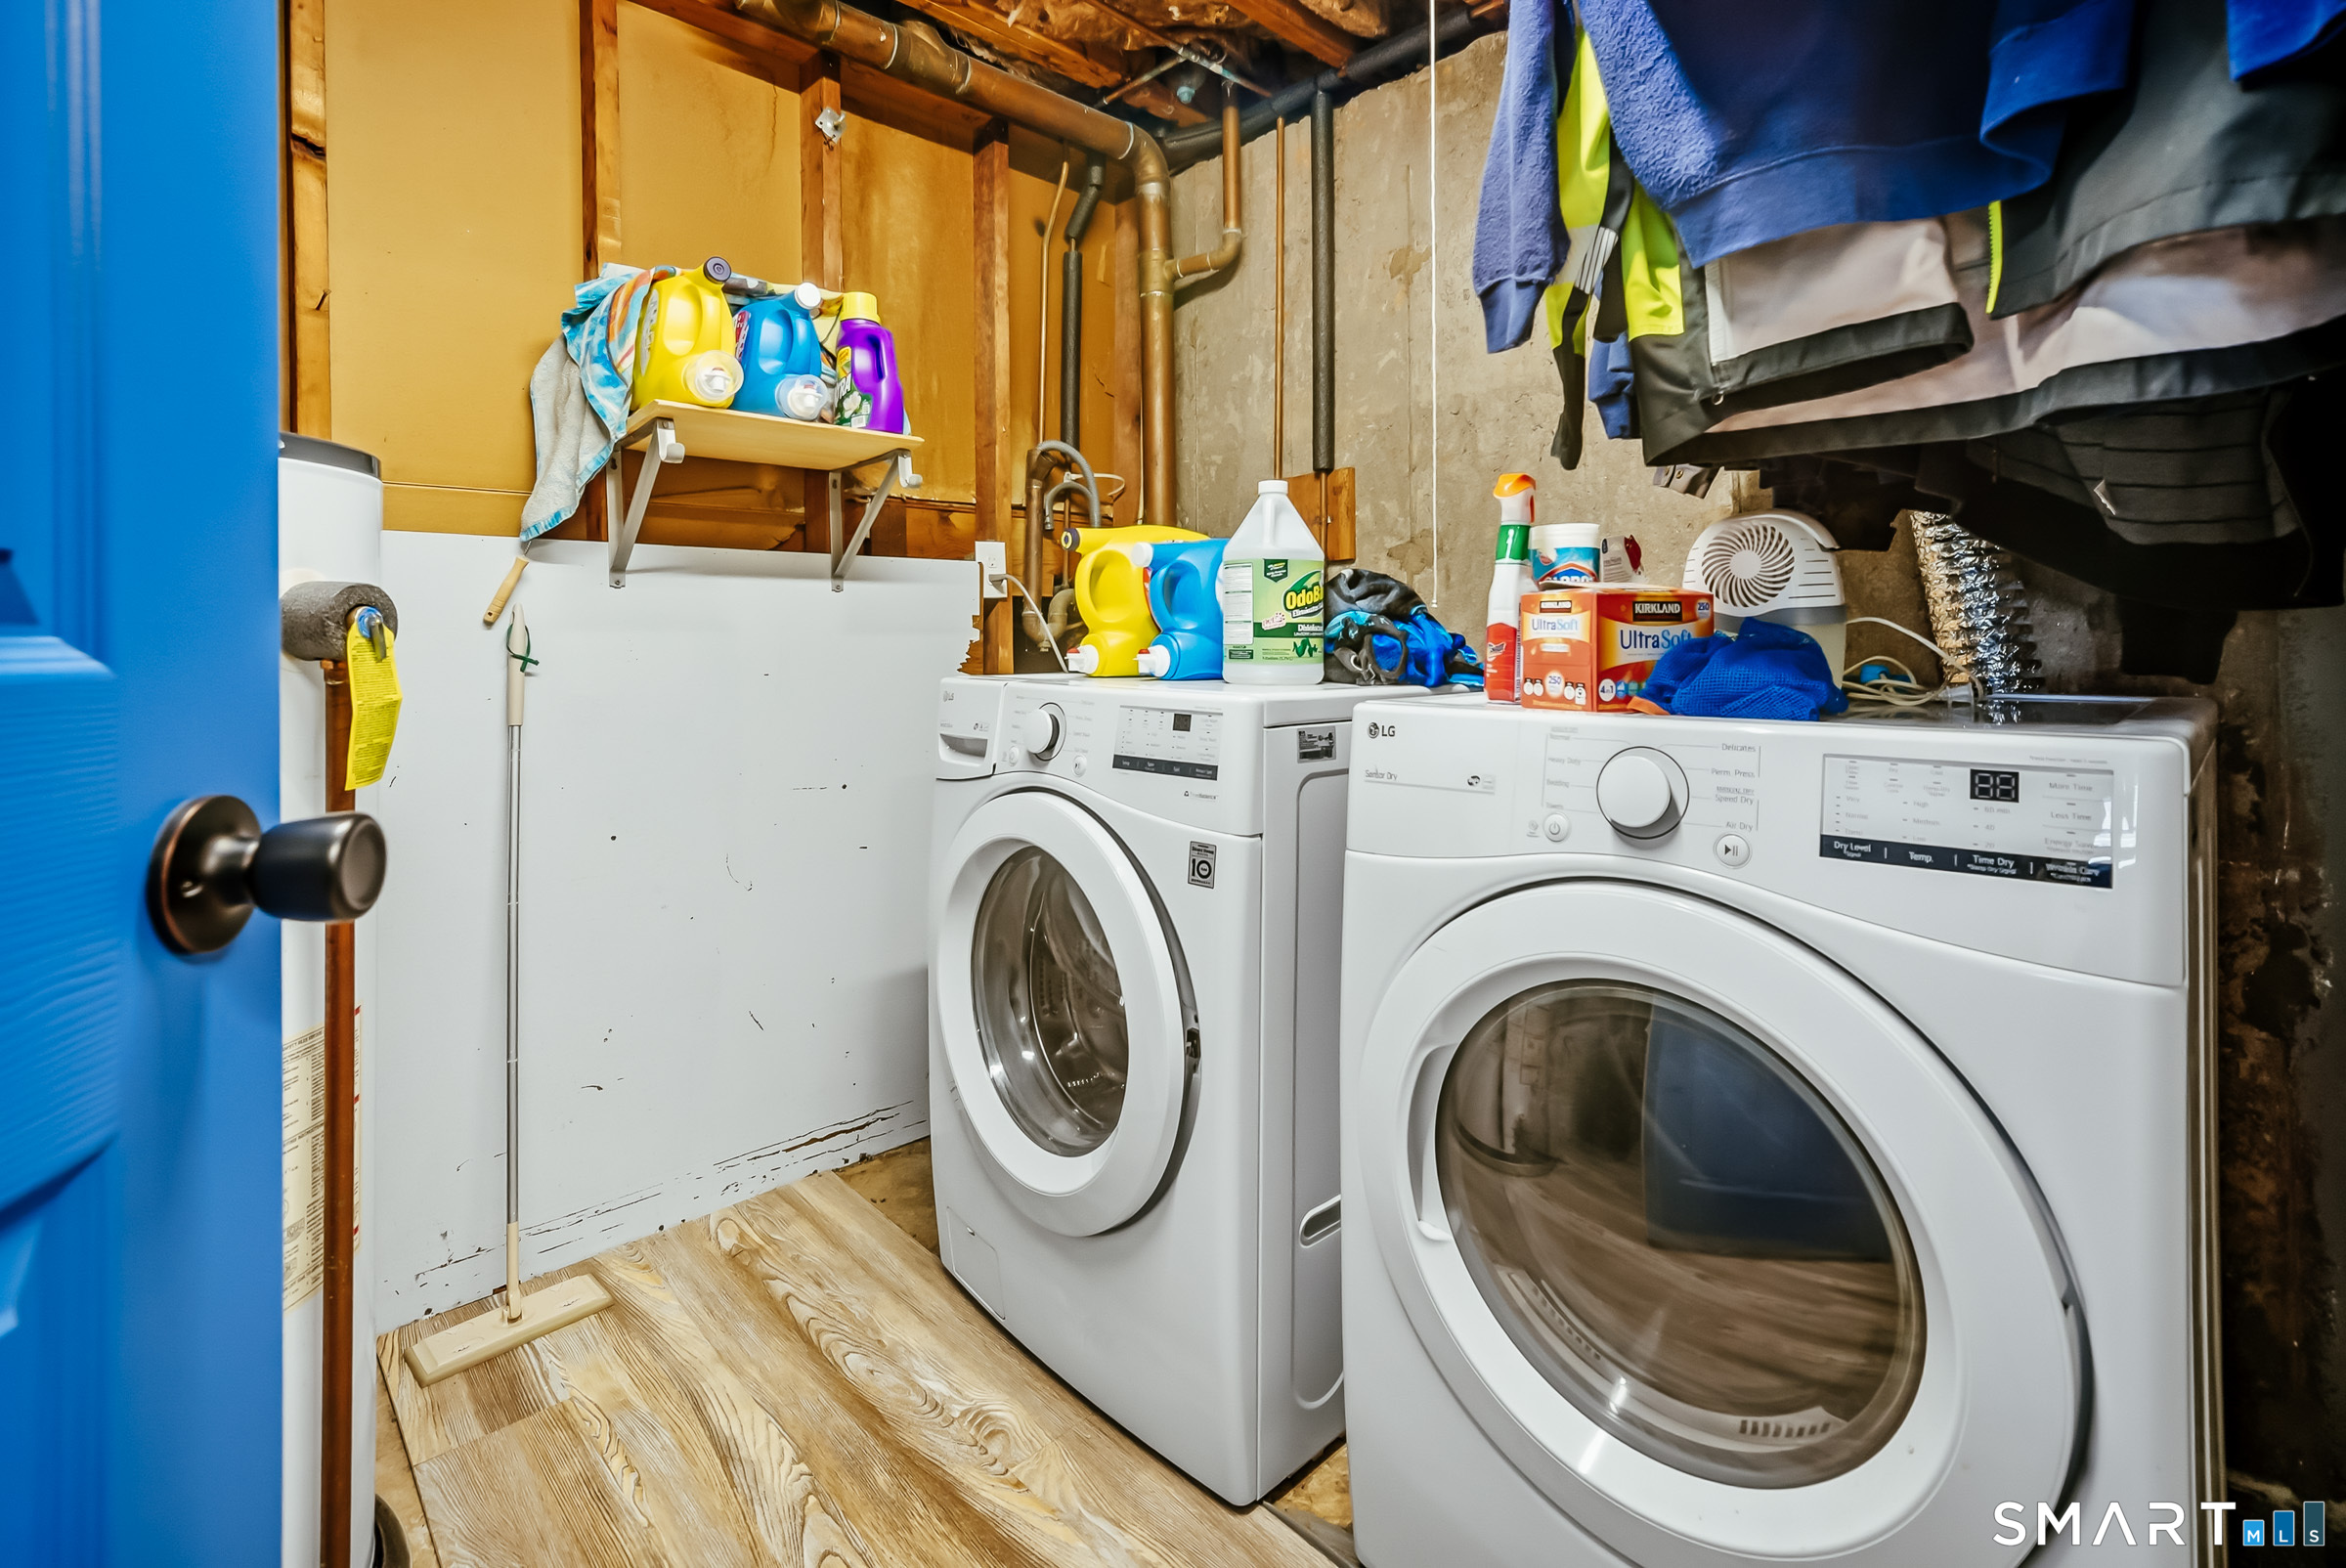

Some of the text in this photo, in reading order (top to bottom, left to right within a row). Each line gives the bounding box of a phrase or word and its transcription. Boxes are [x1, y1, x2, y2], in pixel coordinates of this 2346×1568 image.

[1635, 603, 1680, 614] KIRKLAND
[1532, 618, 1578, 632] UltraSoft
[1381, 725, 1396, 737] LG
[1721, 743, 1757, 752] Delicates
[1387, 771, 1398, 781] Dry
[2073, 783, 2094, 792] Time
[1740, 796, 1754, 806] Dry
[2072, 812, 2093, 821] Time
[1739, 821, 1754, 833] Dry
[1834, 841, 1872, 853] Dry Level
[1973, 853, 2015, 869] Time Dry
